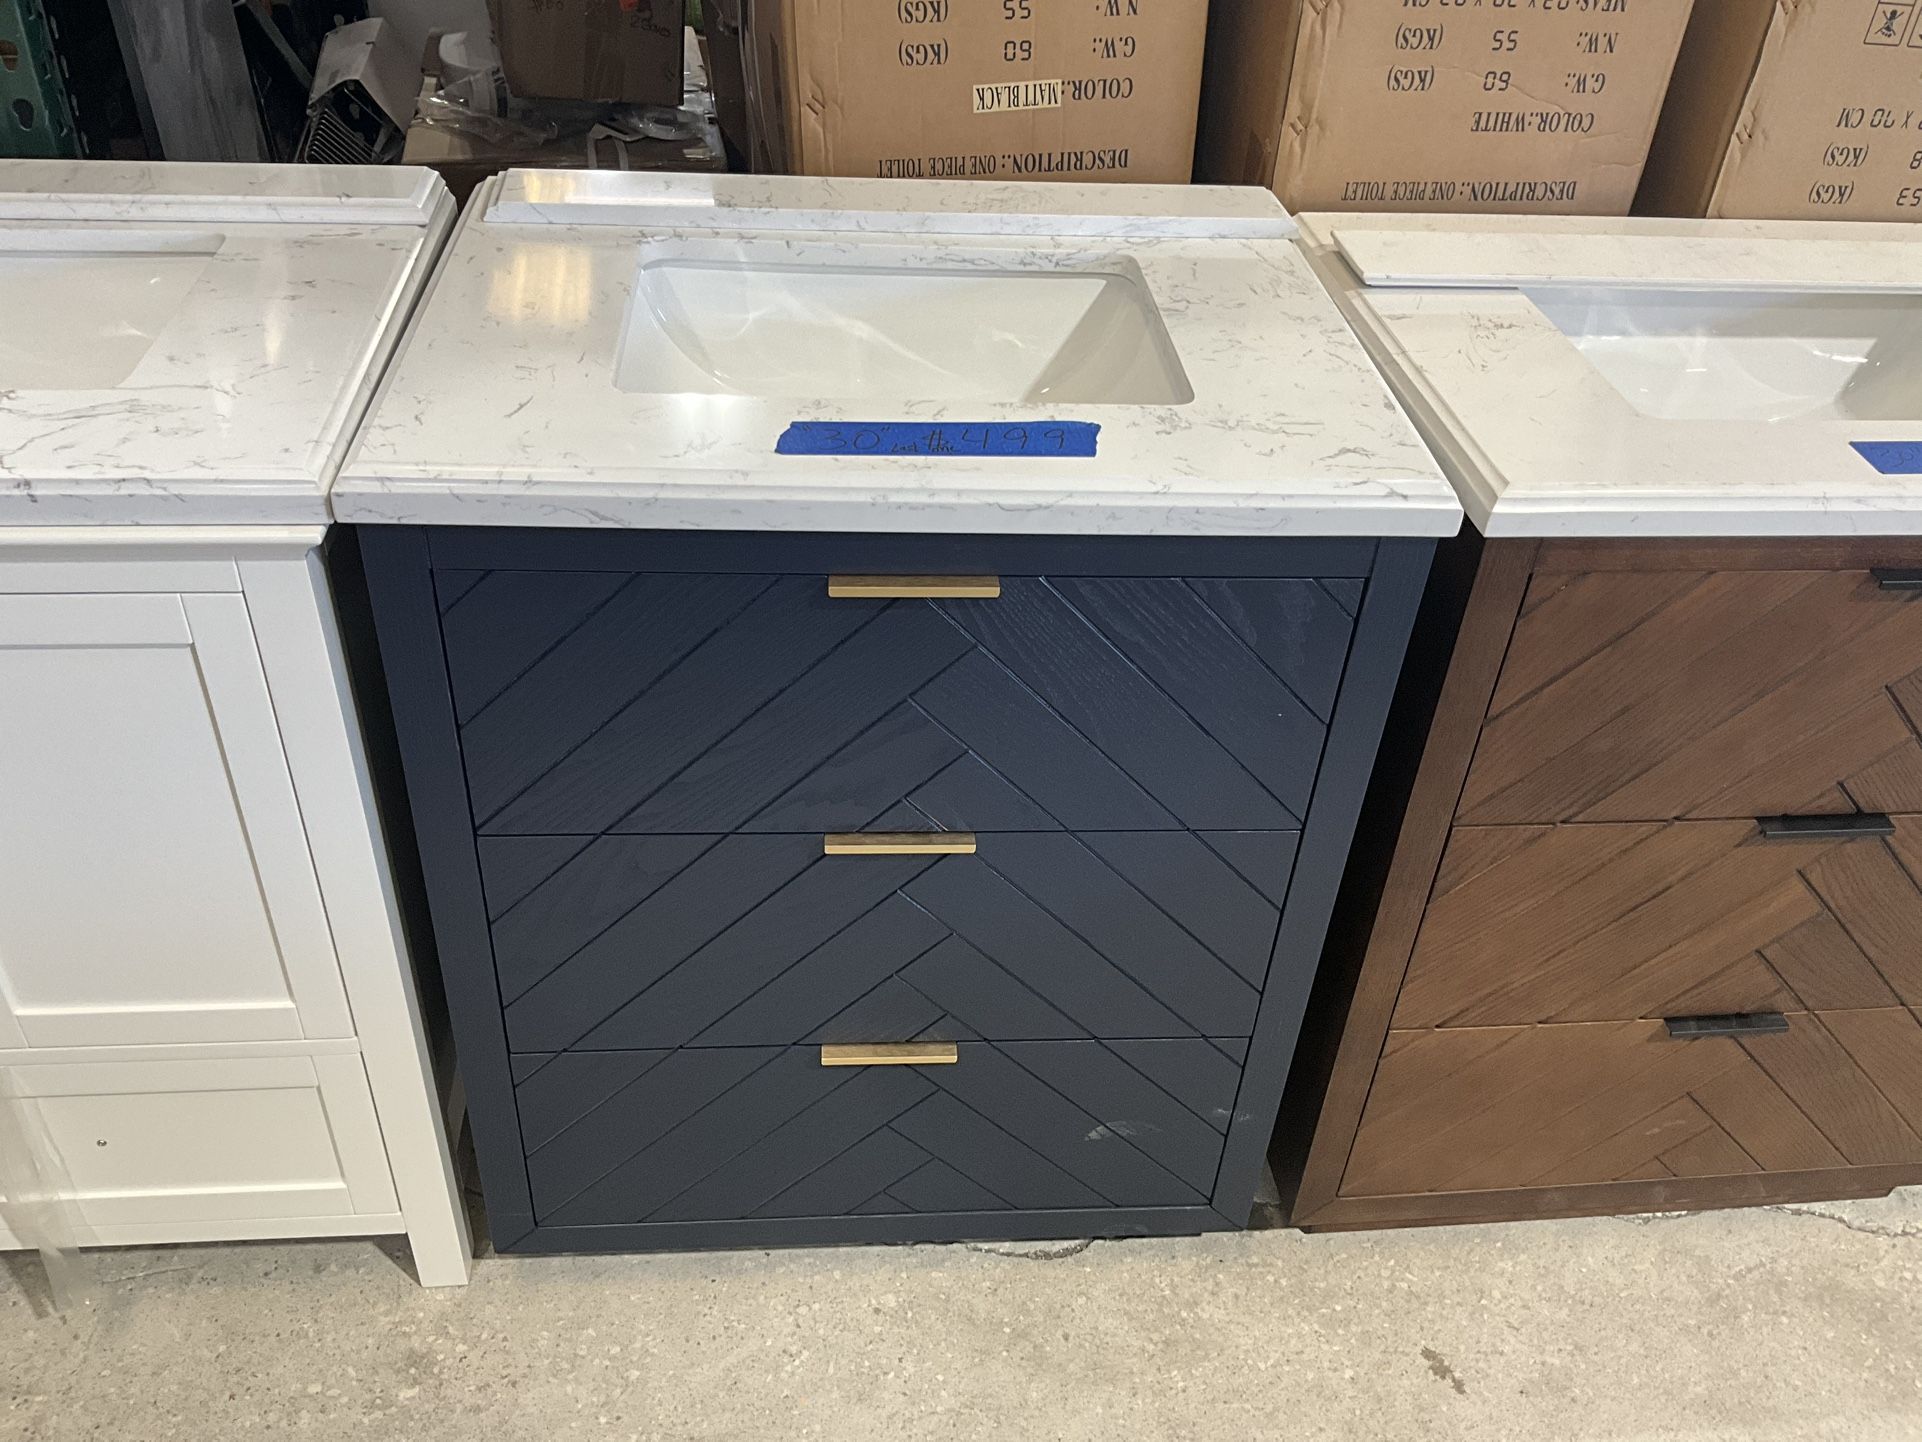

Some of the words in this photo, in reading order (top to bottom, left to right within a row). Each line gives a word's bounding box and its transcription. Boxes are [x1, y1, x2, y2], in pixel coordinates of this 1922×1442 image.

[898, 0, 950, 24] (KGS)
[1003, 0, 1031, 19] 55
[1395, 23, 1444, 51] (KGS)
[1491, 29, 1519, 51] 55
[898, 38, 949, 67] (KGS)
[1003, 40, 1032, 61] 60
[1387, 64, 1435, 92] (KGS)
[1483, 70, 1511, 91] 60
[975, 86, 1020, 111] BLACK
[1022, 82, 1059, 106] MATT
[1836, 107, 1864, 128] CM
[928, 155, 966, 177] PIECE
[969, 154, 997, 176] ONE
[1823, 143, 1870, 168] (KGS)
[877, 158, 924, 178] TOILET
[1341, 181, 1388, 201] TOILET
[1390, 181, 1428, 201] PIECE
[1428, 181, 1456, 201] ONE
[1808, 180, 1856, 205] (KGS)
